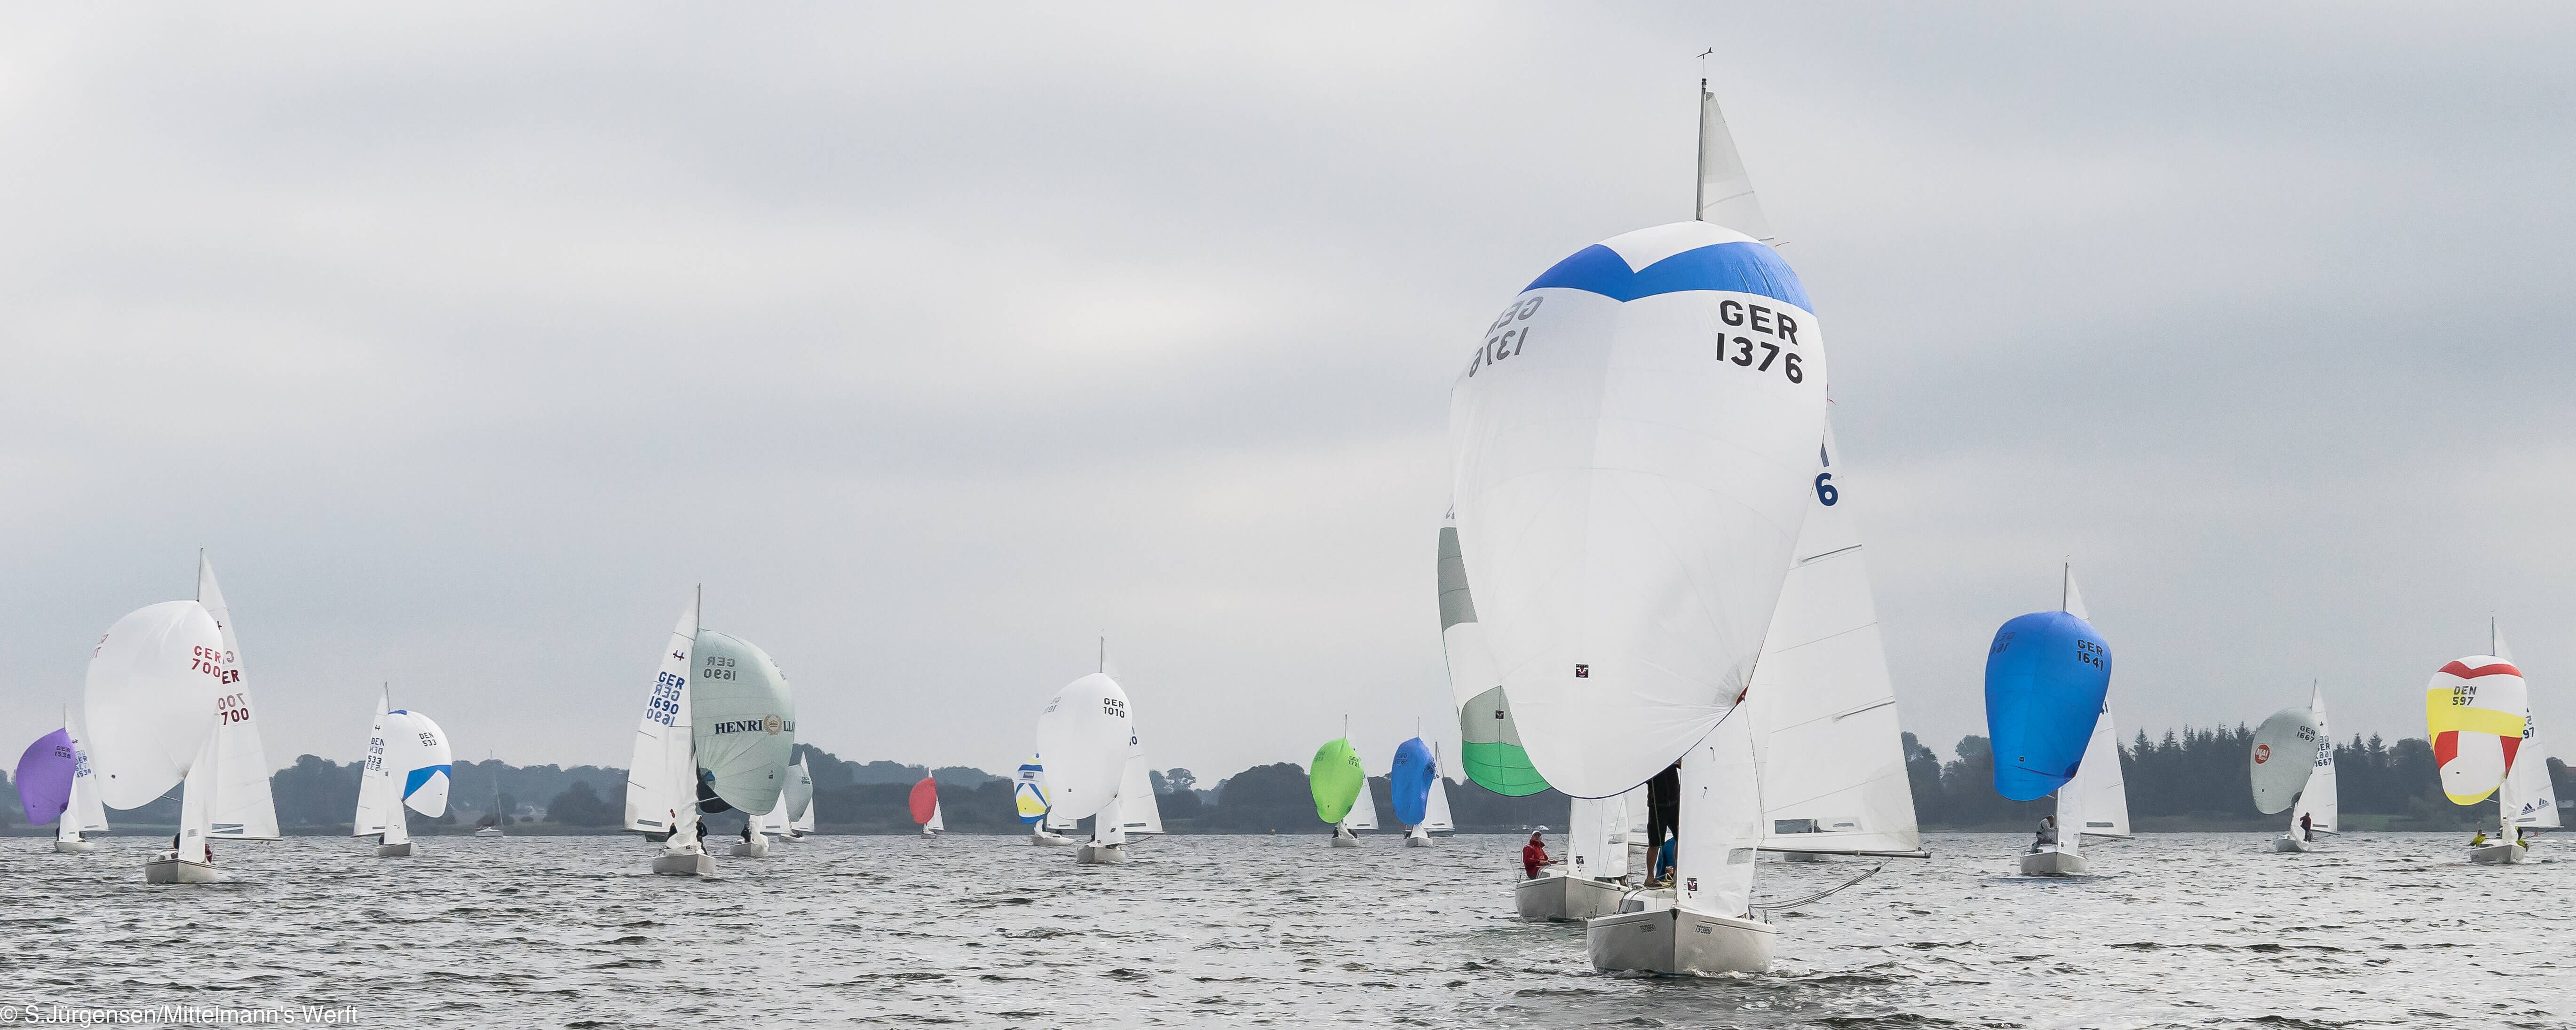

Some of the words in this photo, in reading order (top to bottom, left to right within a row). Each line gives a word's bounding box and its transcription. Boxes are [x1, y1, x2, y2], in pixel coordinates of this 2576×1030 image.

[1720, 300, 1798, 346] GER
[1716, 332, 1803, 384] 1376
[194, 645, 222, 663] GER
[2077, 639, 2103, 657] GER
[191, 658, 221, 677] 700
[2077, 651, 2103, 671] 1641
[222, 669, 240, 684] ER
[658, 671, 685, 690] GER
[2453, 686, 2477, 695] DEN
[649, 696, 679, 715] 1690
[1103, 698, 1124, 709] GER
[2452, 697, 2474, 706] 597
[221, 708, 249, 725] 700
[1103, 707, 1125, 718] 1010
[714, 720, 763, 734] HENRI
[2299, 725, 2315, 736] GER
[2522, 727, 2534, 739] 97
[2296, 731, 2315, 742] 1667
[2318, 743, 2330, 752] ER
[368, 755, 382, 764] 533
[2315, 758, 2332, 767] 1667
